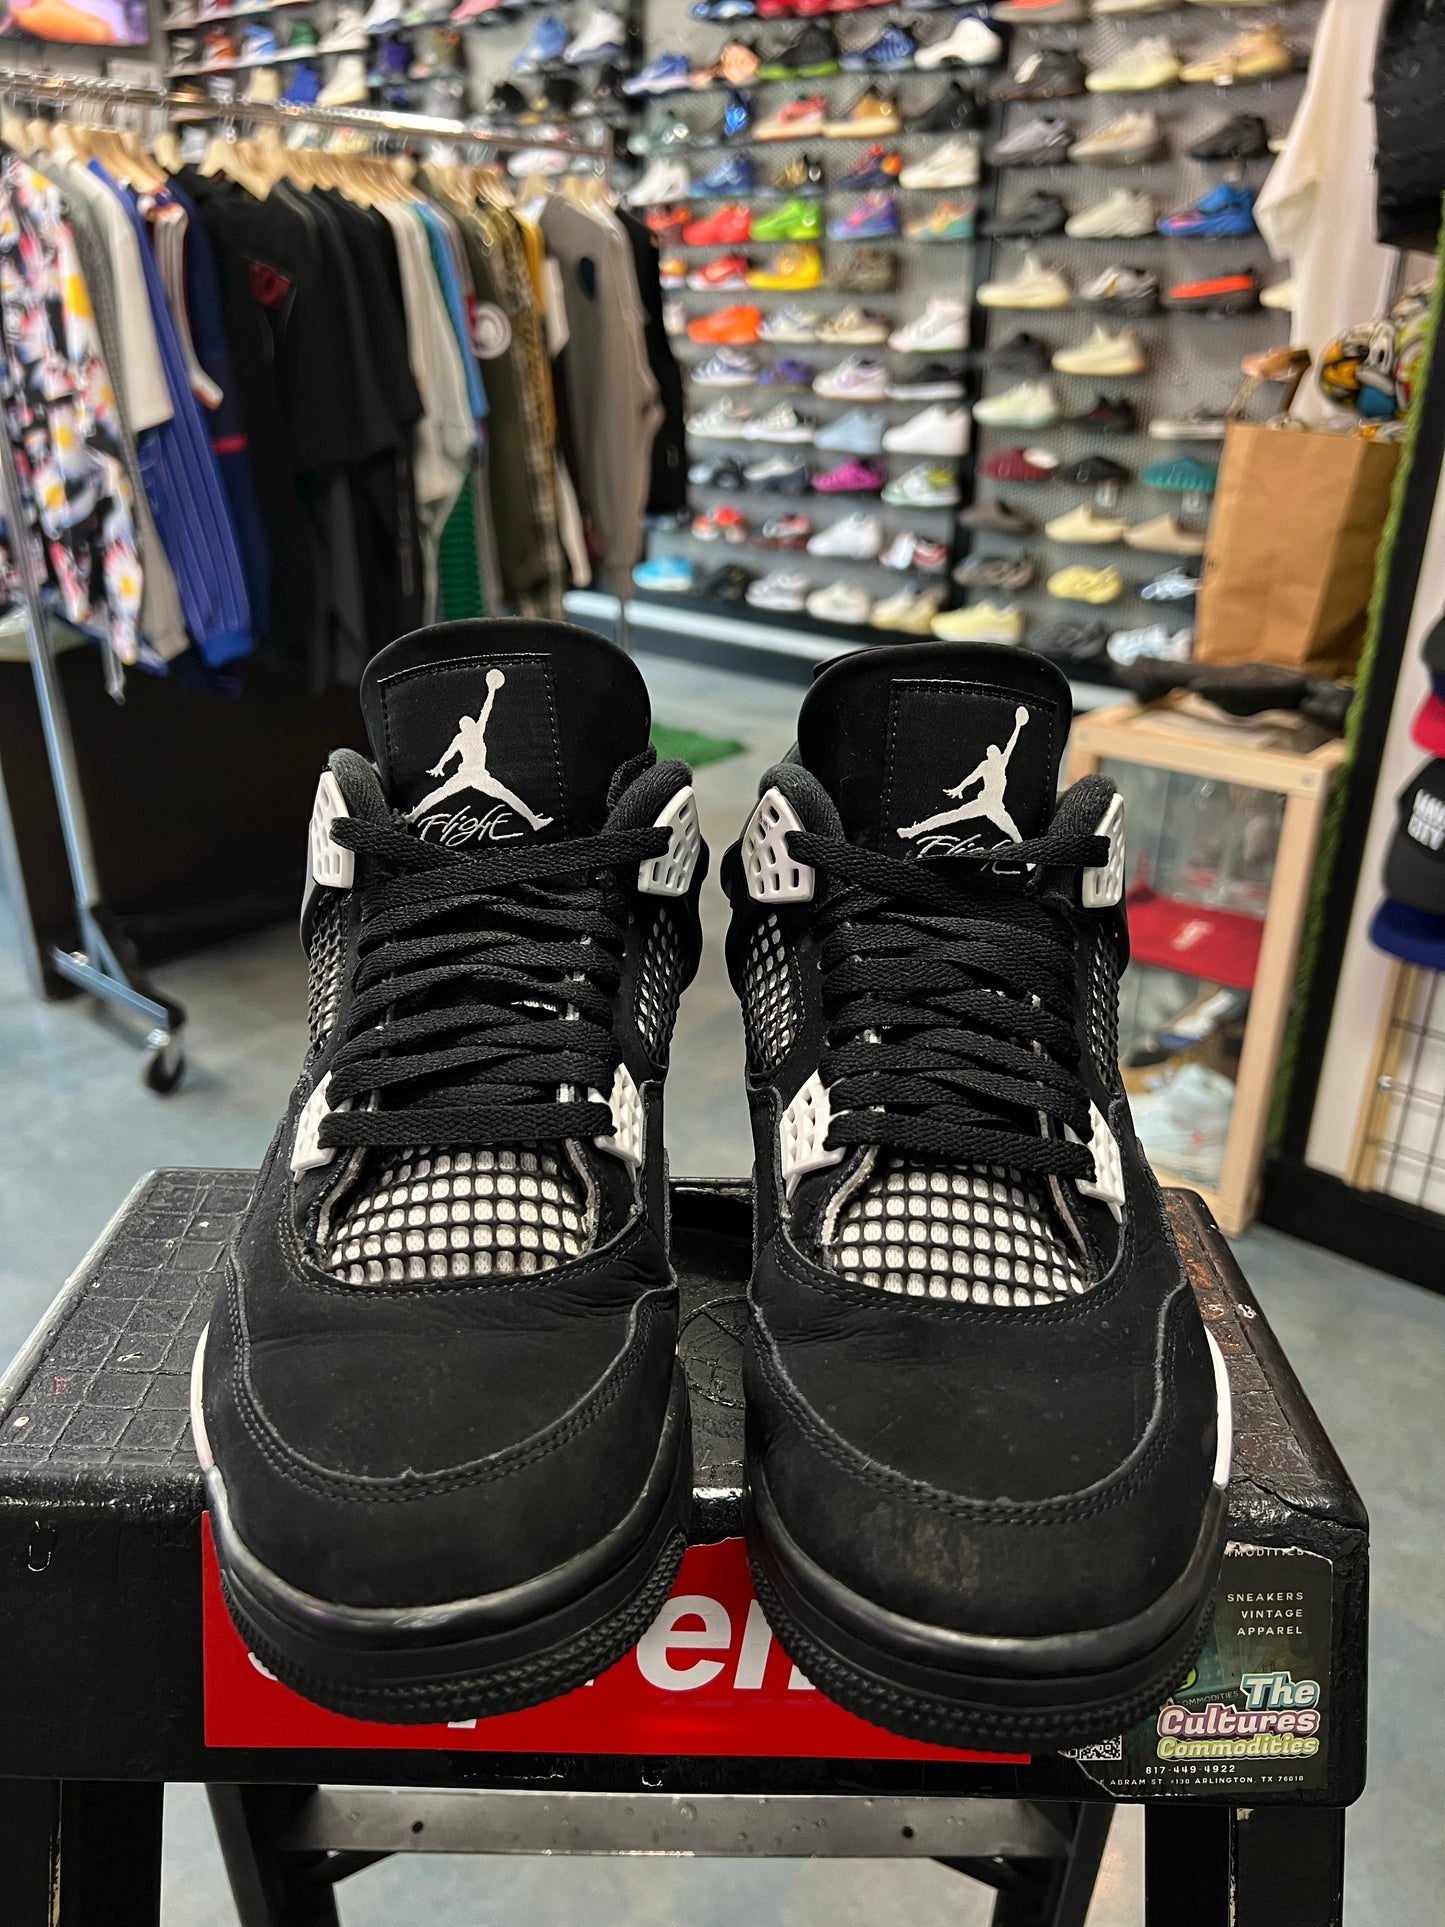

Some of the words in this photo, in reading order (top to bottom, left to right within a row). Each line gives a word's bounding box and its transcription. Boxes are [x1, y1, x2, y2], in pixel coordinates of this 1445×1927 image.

[1227, 1591, 1304, 1602] SNEAKERS
[1241, 1608, 1303, 1619] VINTAGE
[1237, 1625, 1303, 1636] APPAREL
[1242, 1673, 1319, 1708] The
[1159, 1705, 1319, 1737] Cultures
[1158, 1732, 1319, 1758] Commodities
[1145, 1764, 1236, 1775] 817-449-4922
[1110, 1778, 1146, 1786] ABRAM
